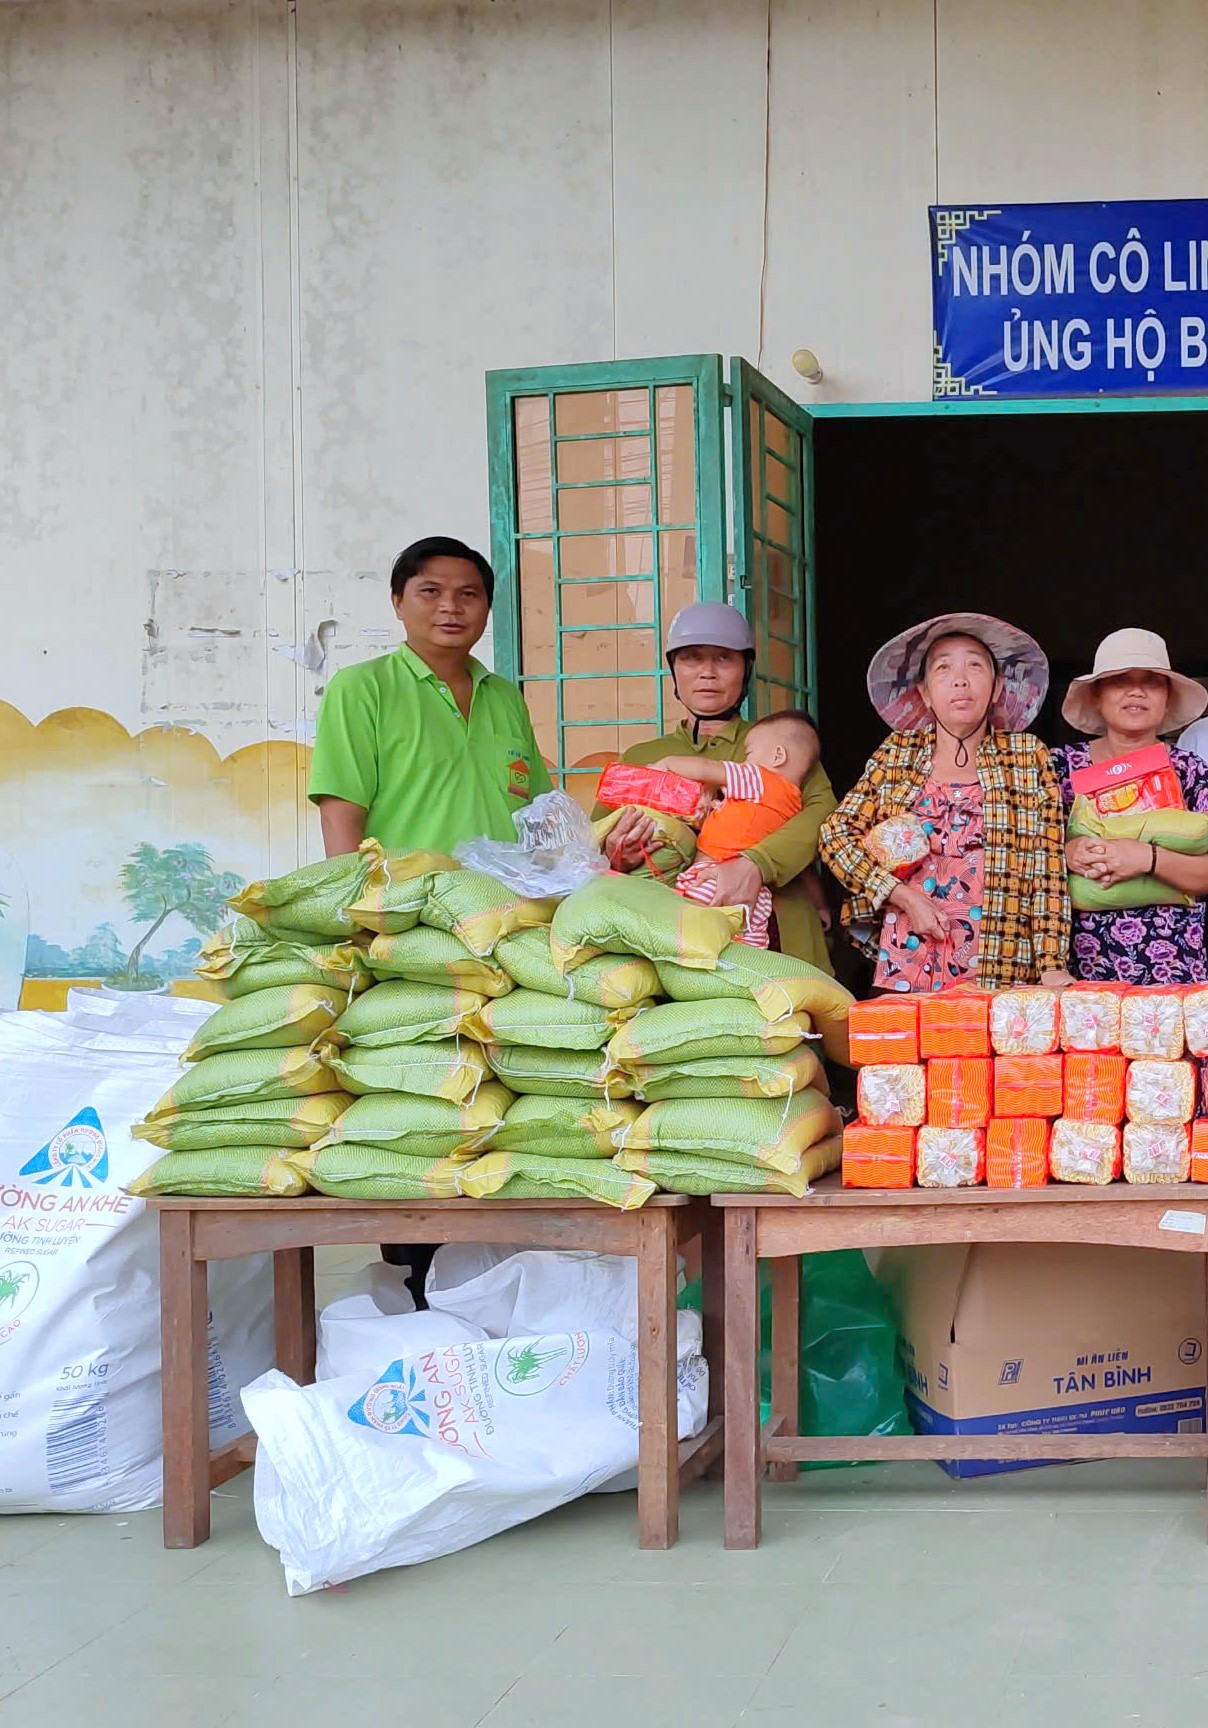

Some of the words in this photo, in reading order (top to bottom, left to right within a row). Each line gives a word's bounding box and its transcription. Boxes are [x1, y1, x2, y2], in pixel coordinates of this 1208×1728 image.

[952, 231, 1074, 297] NHÓM
[1089, 227, 1150, 294] CÔ
[1002, 307, 1092, 373] ỦNG
[1106, 308, 1167, 381] HỘ
[0, 1184, 57, 1213] ỜNG
[58, 1195, 90, 1214] AN
[3, 1215, 33, 1231] AK
[35, 1217, 85, 1233] SUGAR
[60, 1365, 84, 1380] 50
[87, 1362, 110, 1377] kg
[420, 1351, 445, 1385] AN
[1053, 1371, 1095, 1395] TÂN
[1104, 1365, 1152, 1388] BÌNH
[459, 1397, 480, 1424] AK
